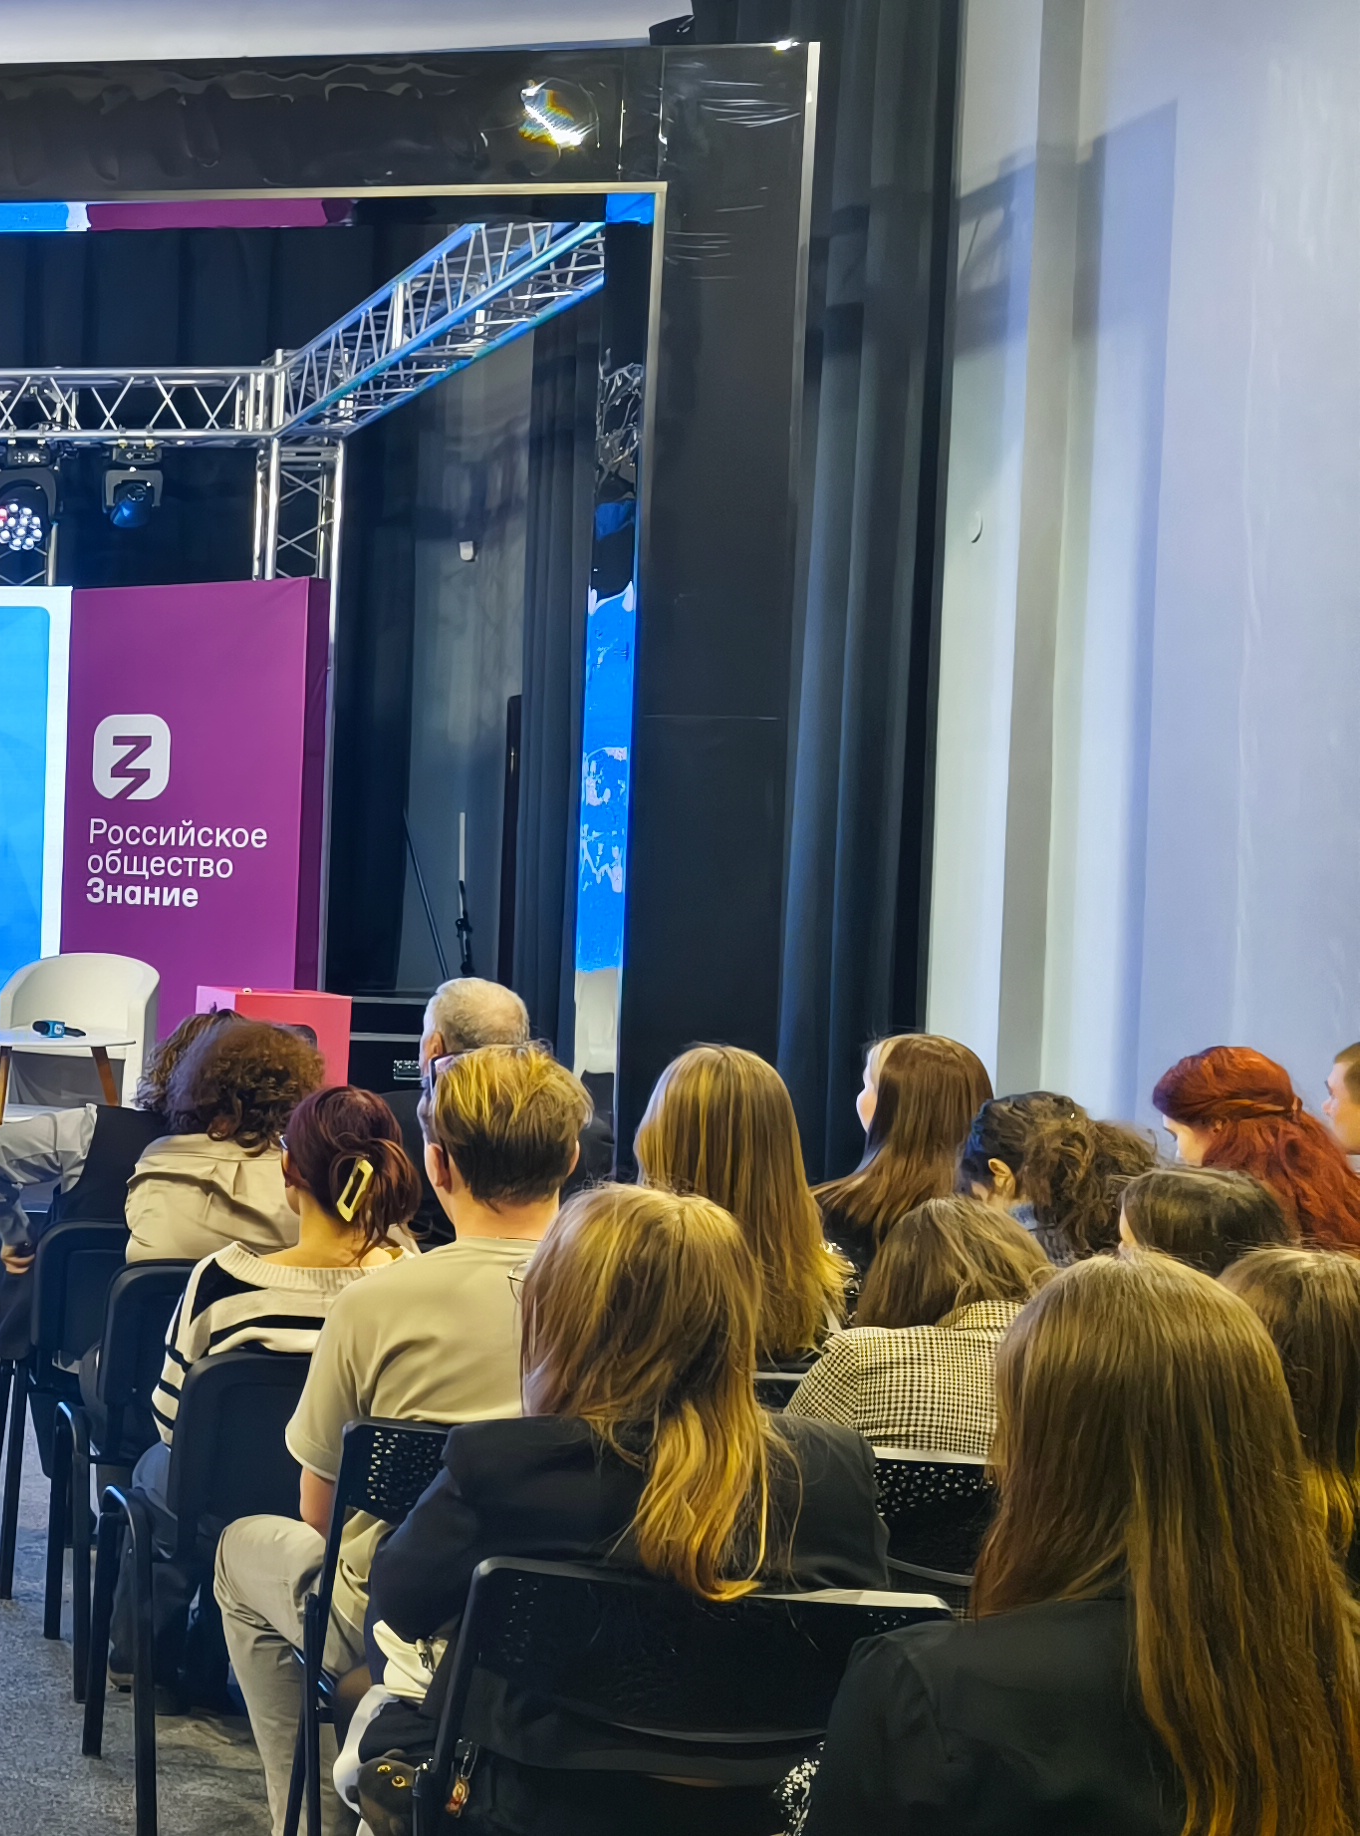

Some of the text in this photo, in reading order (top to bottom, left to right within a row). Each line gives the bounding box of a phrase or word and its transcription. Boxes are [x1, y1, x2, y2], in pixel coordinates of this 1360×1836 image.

[88, 817, 268, 849] Российское
[87, 848, 234, 880] общество
[86, 877, 199, 908] Знание
